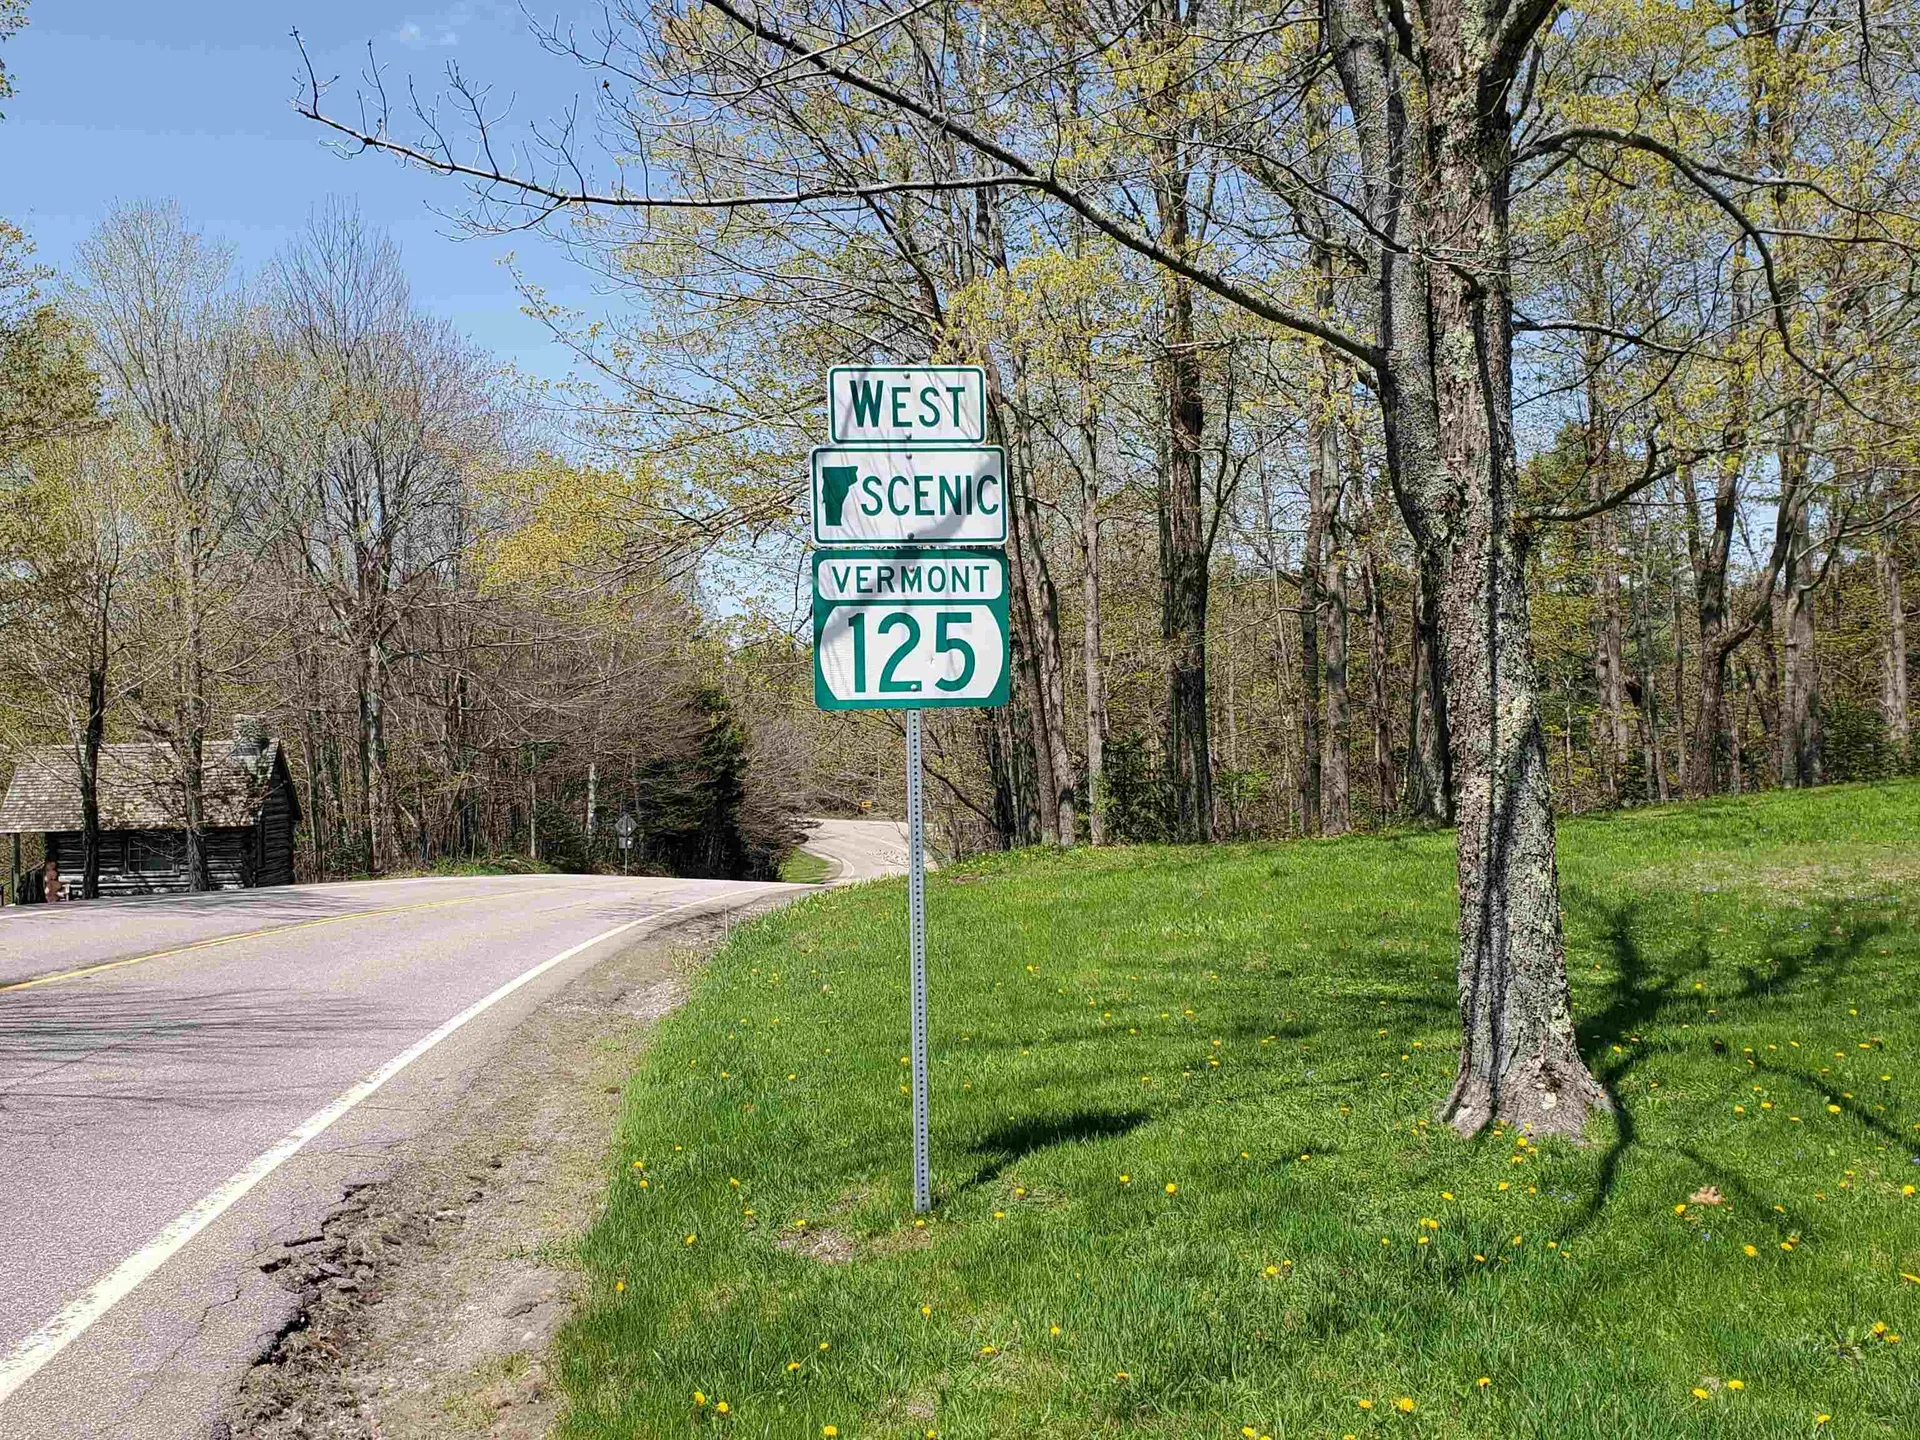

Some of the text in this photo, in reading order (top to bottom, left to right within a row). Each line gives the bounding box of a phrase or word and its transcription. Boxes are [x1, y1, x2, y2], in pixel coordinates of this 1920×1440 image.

[849, 380, 966, 428] WEST
[861, 475, 999, 516] SCENIC
[832, 565, 990, 594] VERMONT
[848, 611, 975, 693] 125
